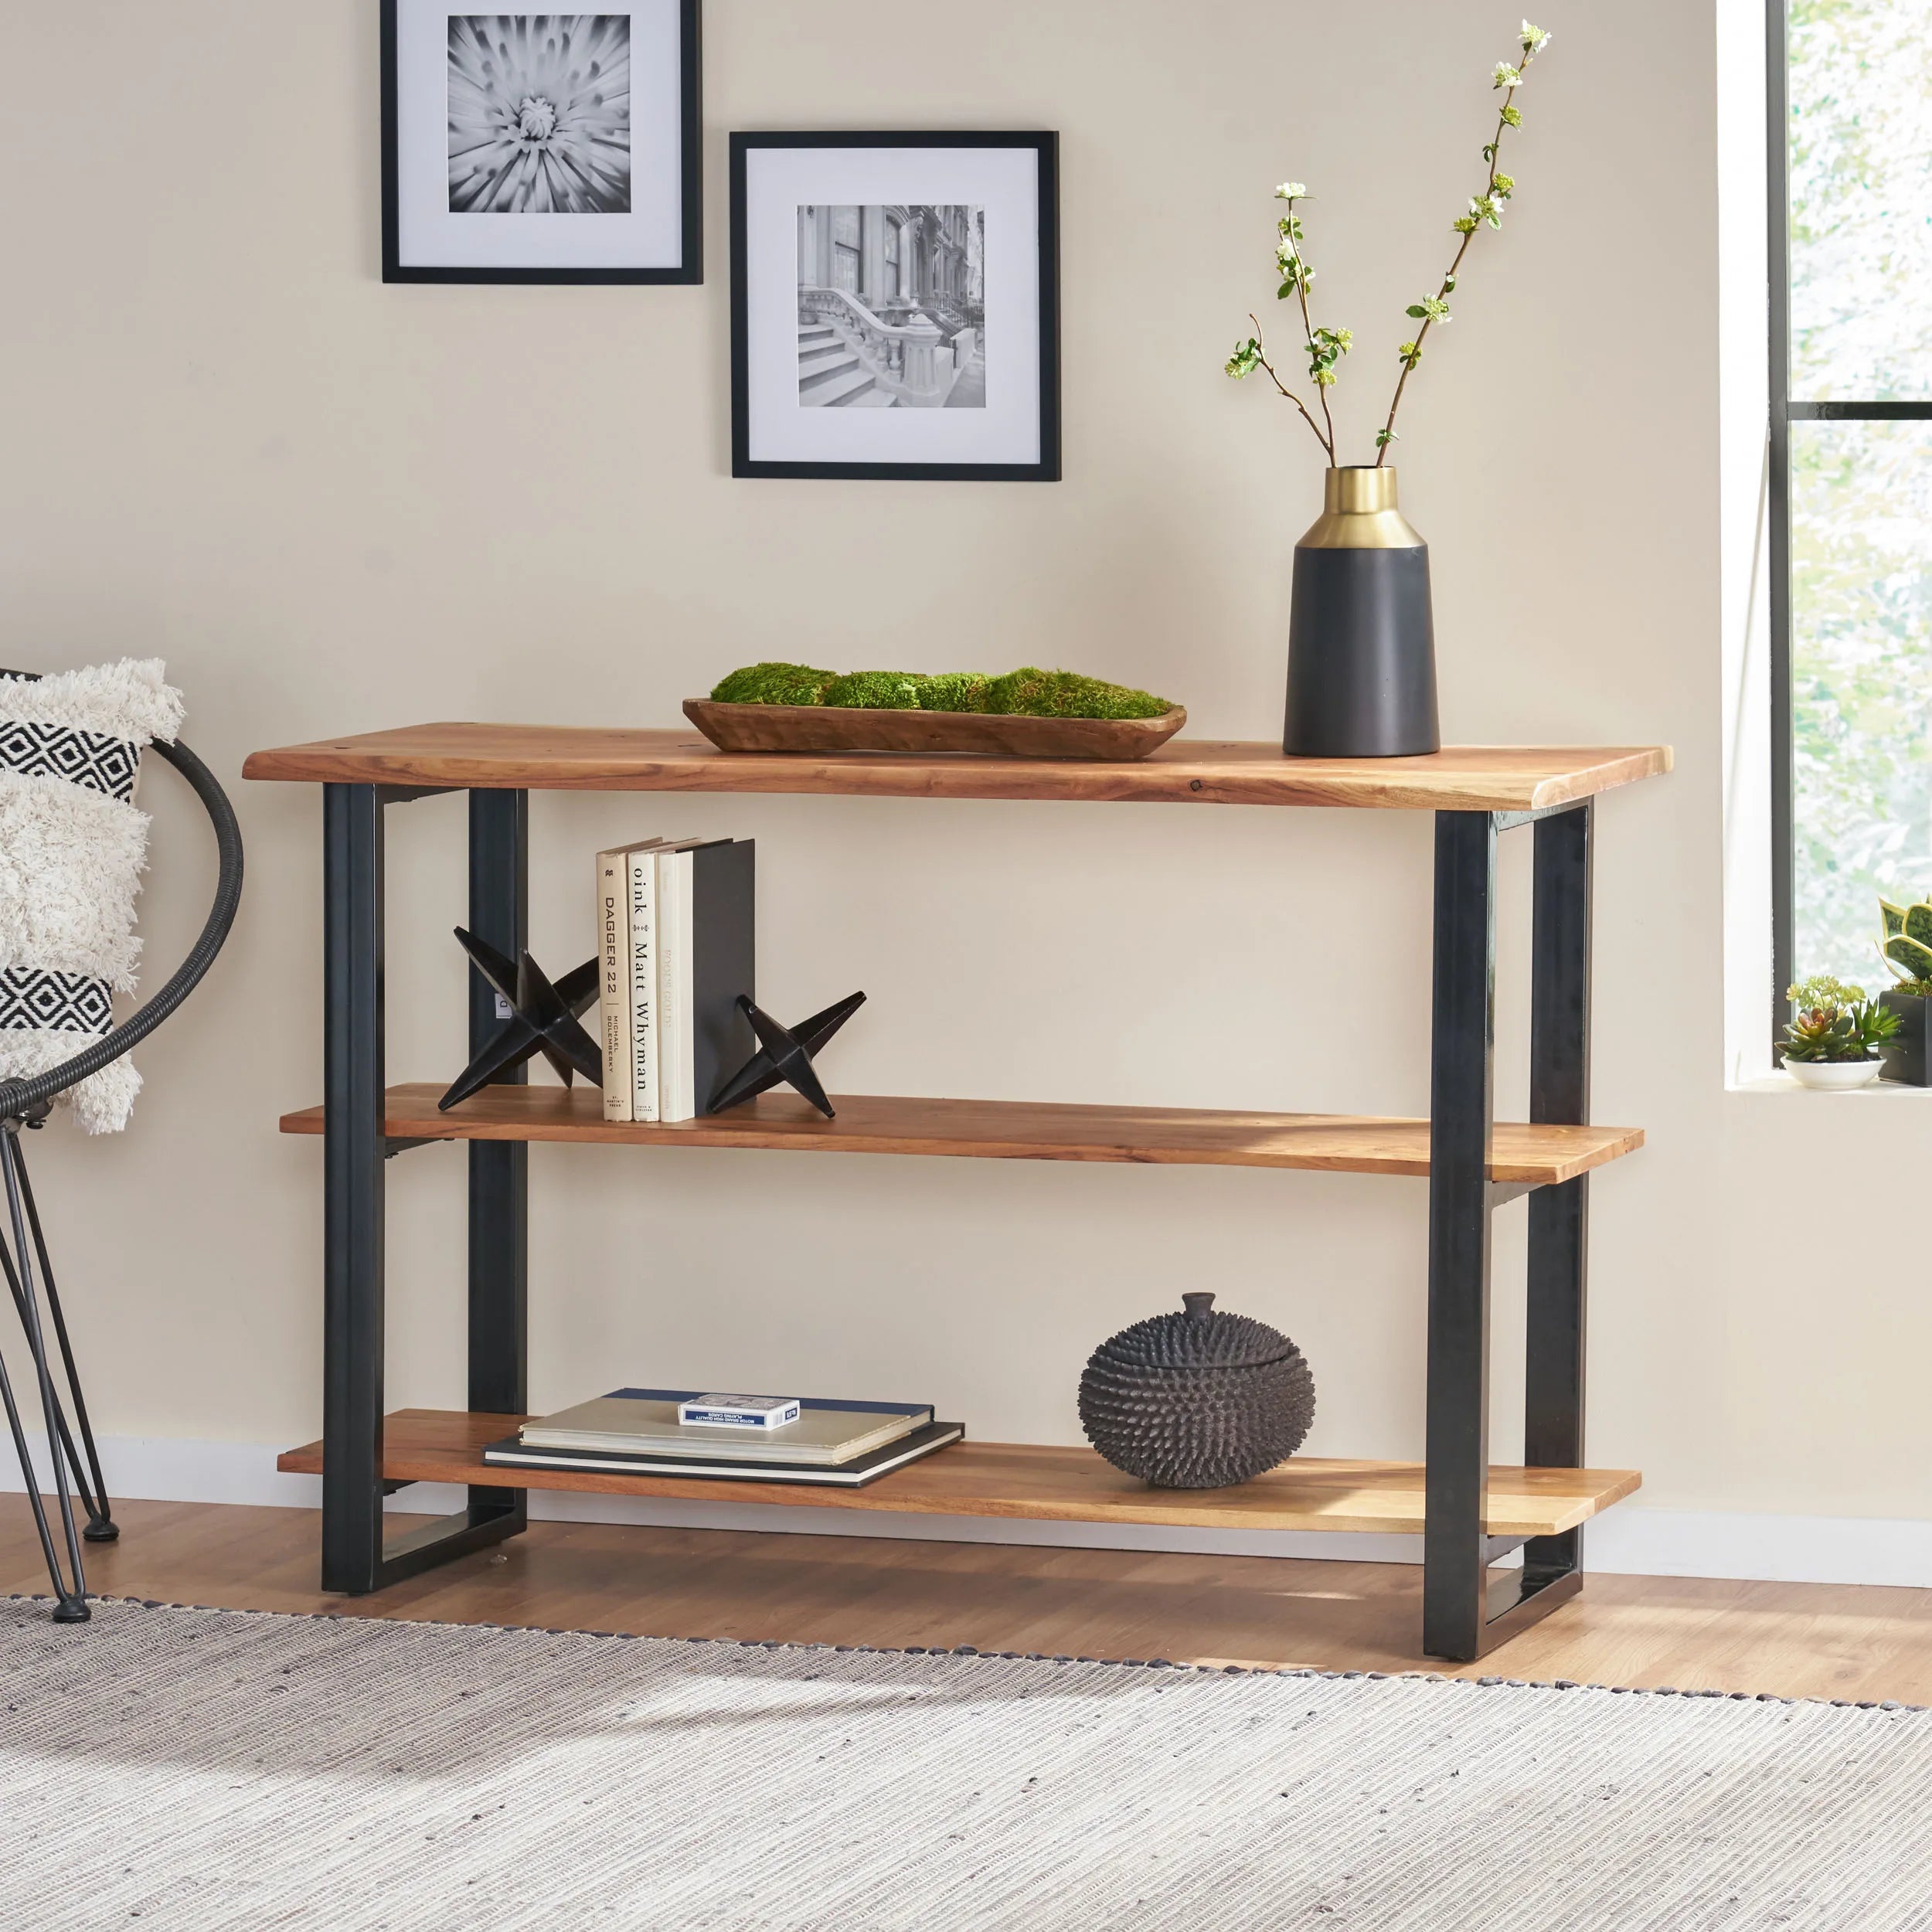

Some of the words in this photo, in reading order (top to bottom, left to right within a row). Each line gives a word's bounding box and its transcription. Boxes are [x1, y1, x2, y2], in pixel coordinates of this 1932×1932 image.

[634, 868, 647, 914] oink
[605, 897, 616, 967] DAGGER
[607, 971, 617, 994] 22
[635, 942, 648, 992] Matt
[634, 1002, 649, 1090] Whyman
